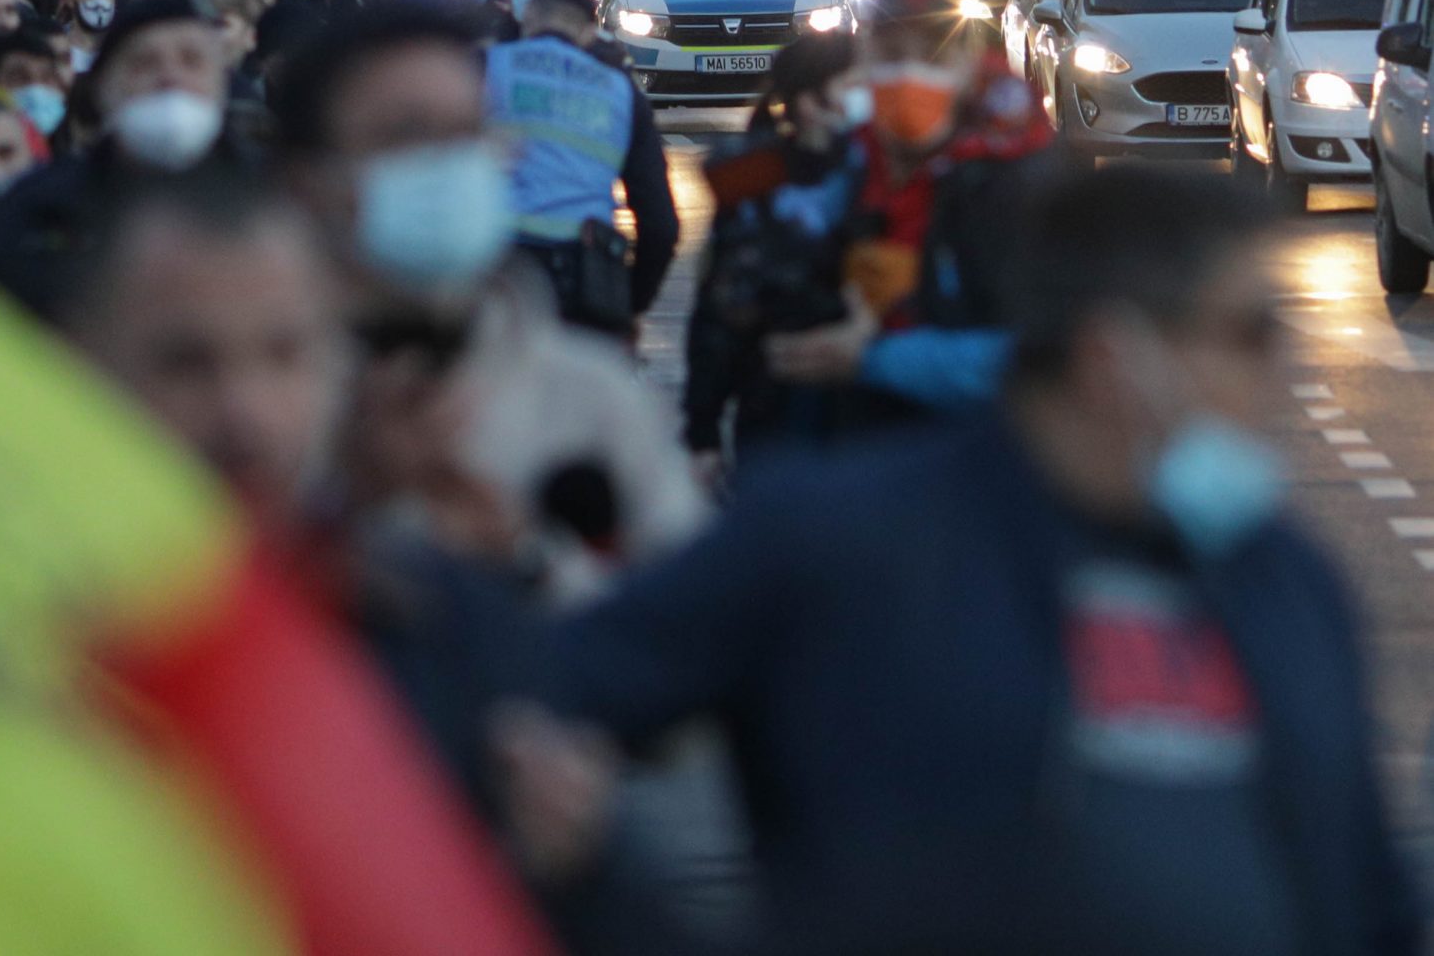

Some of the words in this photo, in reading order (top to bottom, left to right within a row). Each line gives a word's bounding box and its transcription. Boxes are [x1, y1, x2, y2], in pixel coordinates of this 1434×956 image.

[706, 58, 727, 71] MAI
[730, 57, 766, 70] 56510
[1177, 107, 1188, 121] B
[1193, 107, 1220, 121] 775
